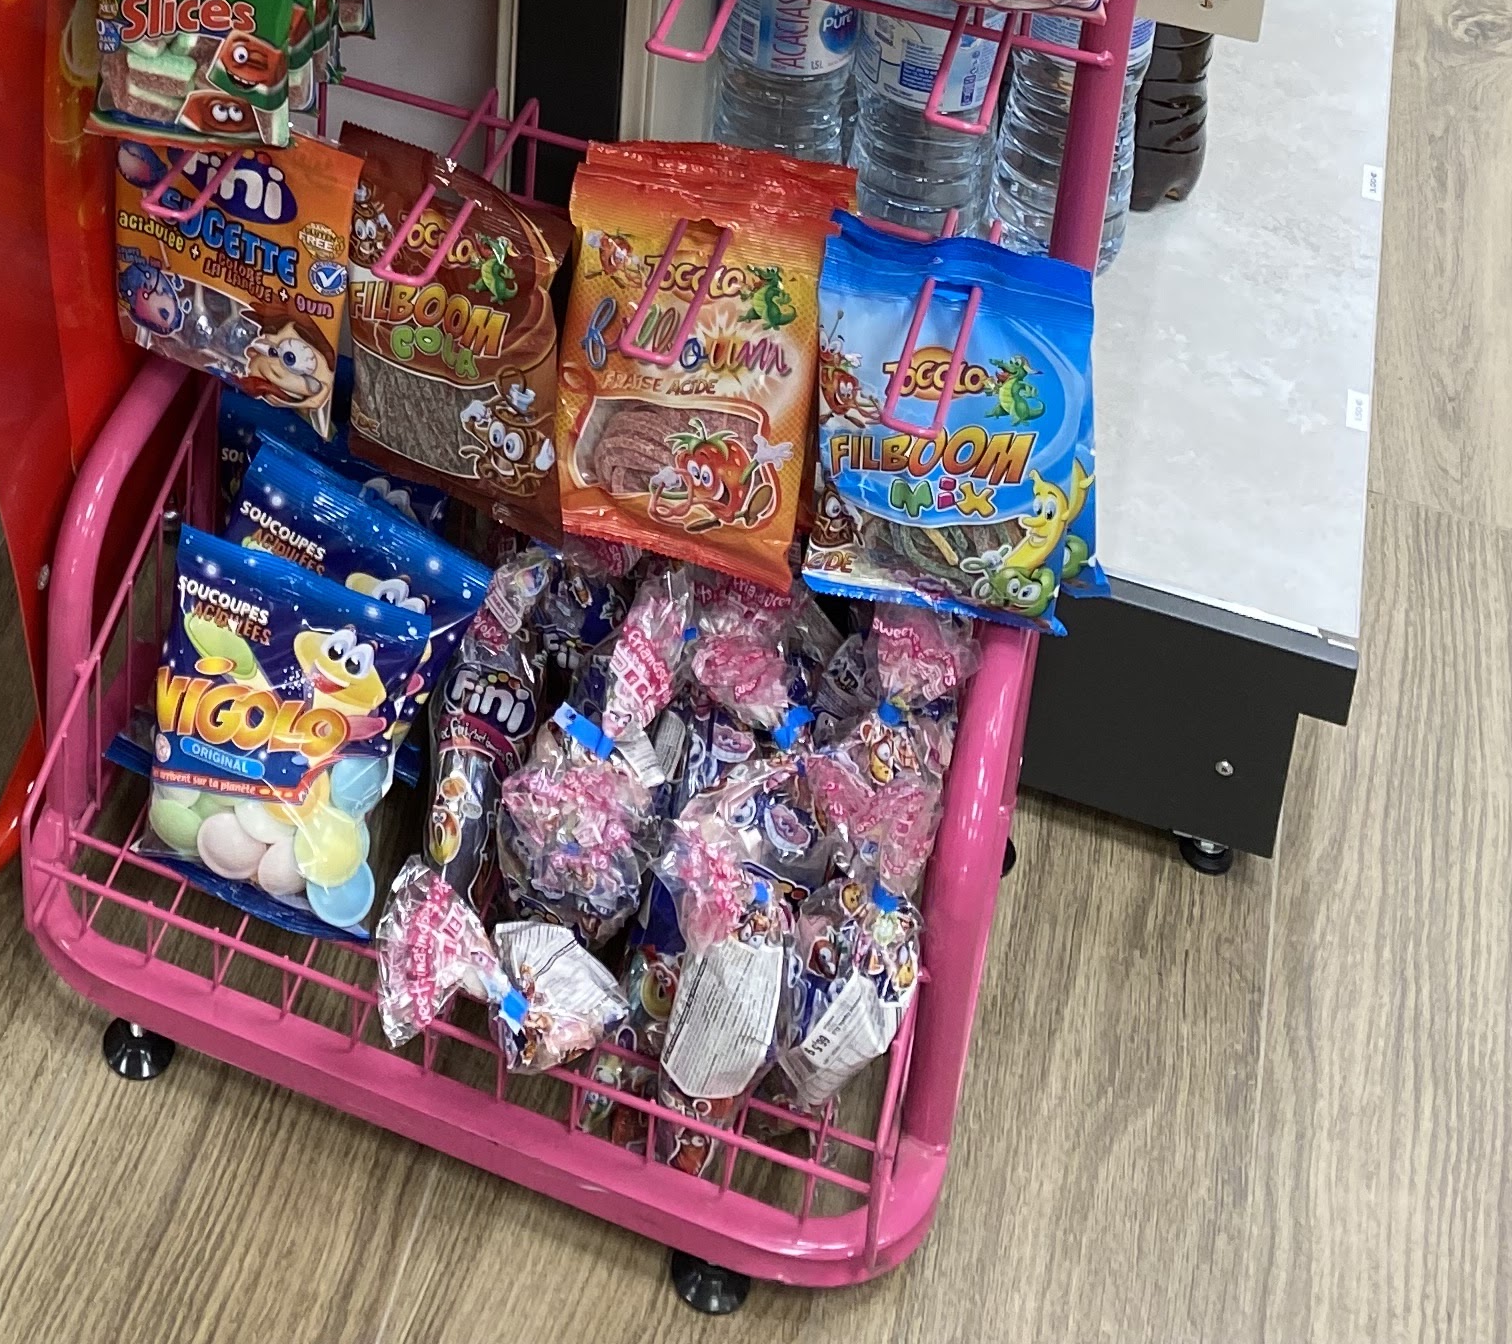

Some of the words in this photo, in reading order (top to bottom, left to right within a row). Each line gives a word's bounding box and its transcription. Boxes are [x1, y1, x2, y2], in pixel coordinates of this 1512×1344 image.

[348, 278, 510, 360] FILBOOM
[389, 325, 480, 380] COLA
[828, 425, 1036, 484] FILBOOM
[239, 499, 327, 563] SOUCOUPES
[178, 574, 271, 626] SOUCOUPES
[450, 668, 535, 728] Fini
[191, 743, 250, 775] ORIGINAL
